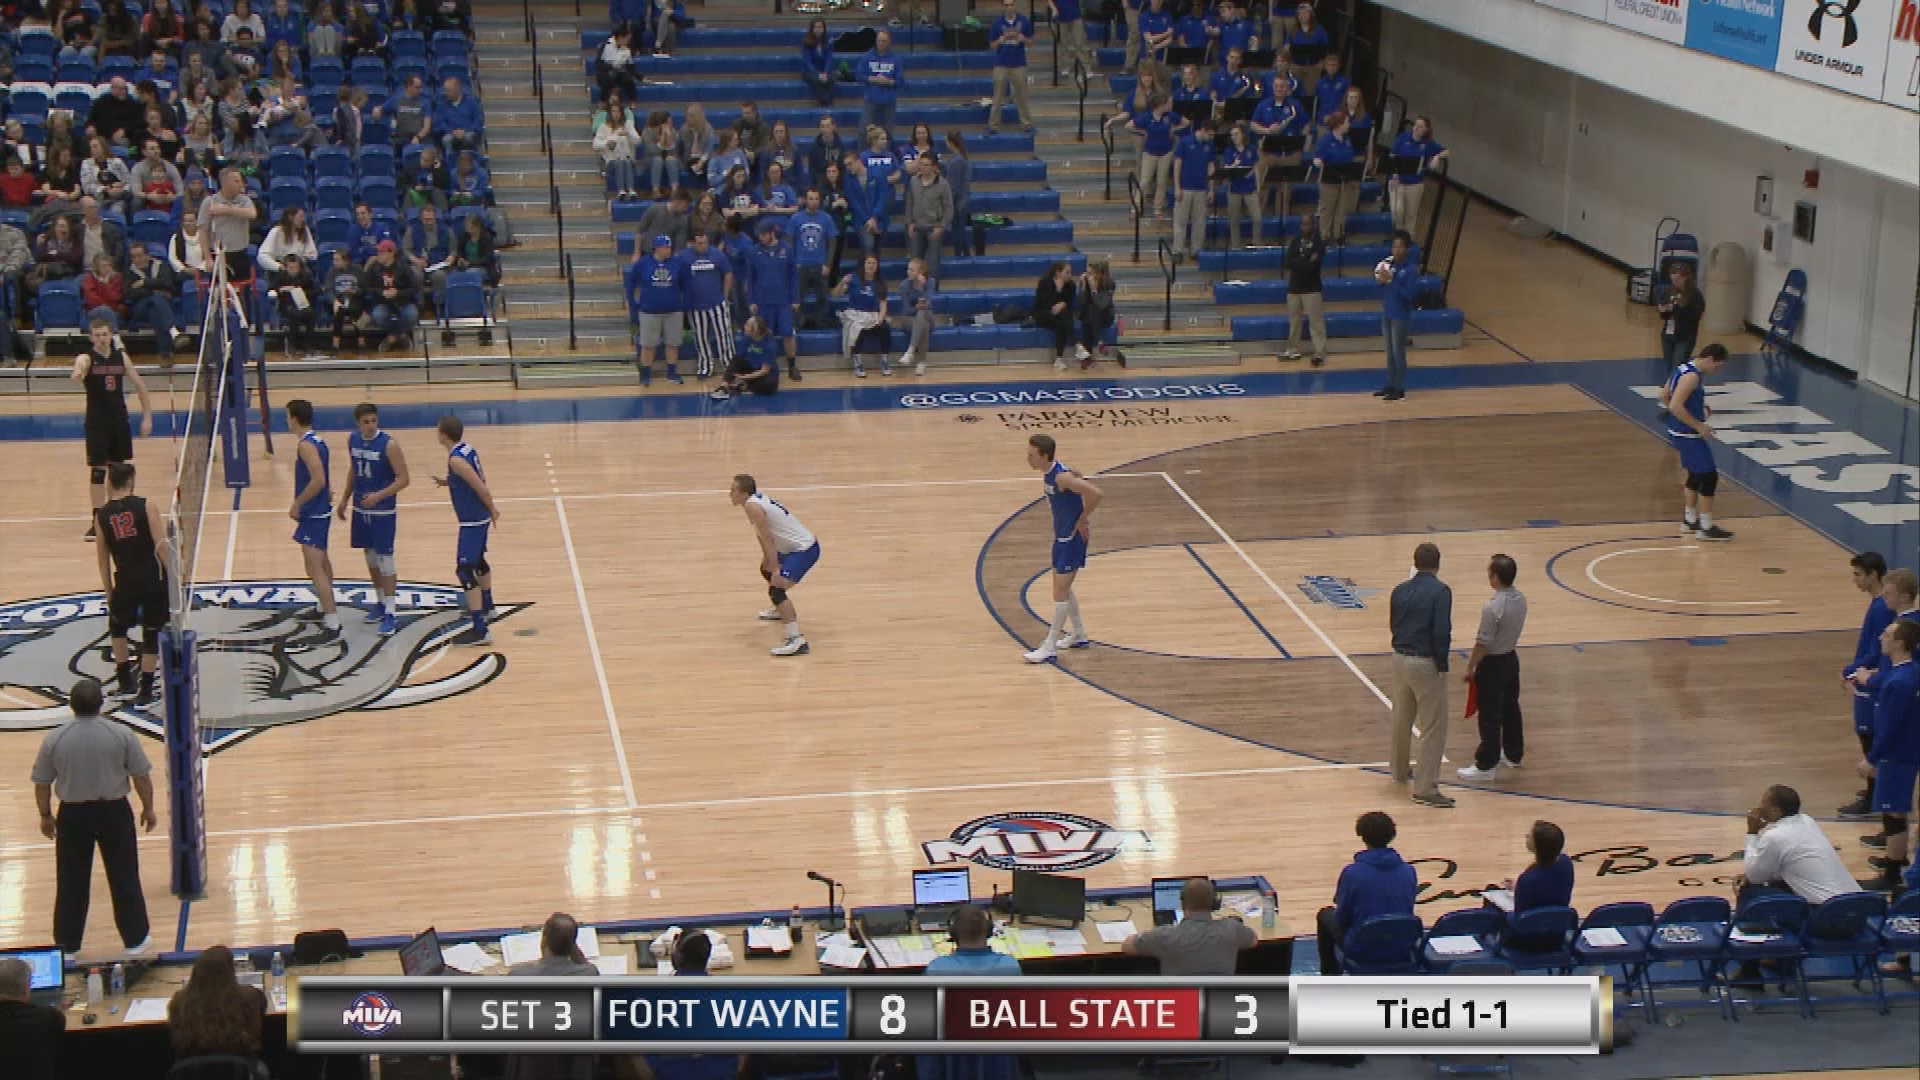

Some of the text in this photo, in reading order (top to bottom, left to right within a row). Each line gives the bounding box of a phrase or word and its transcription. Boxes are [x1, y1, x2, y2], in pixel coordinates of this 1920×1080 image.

[1794, 49, 1864, 77] UNDER ARMOUR
[900, 383, 1246, 408] @GOMASTODONS
[997, 407, 1170, 424] PARKVIEW
[356, 461, 373, 479] 14
[109, 511, 138, 539] 12
[0, 600, 110, 623] FOR
[921, 829, 1152, 865] MIVA
